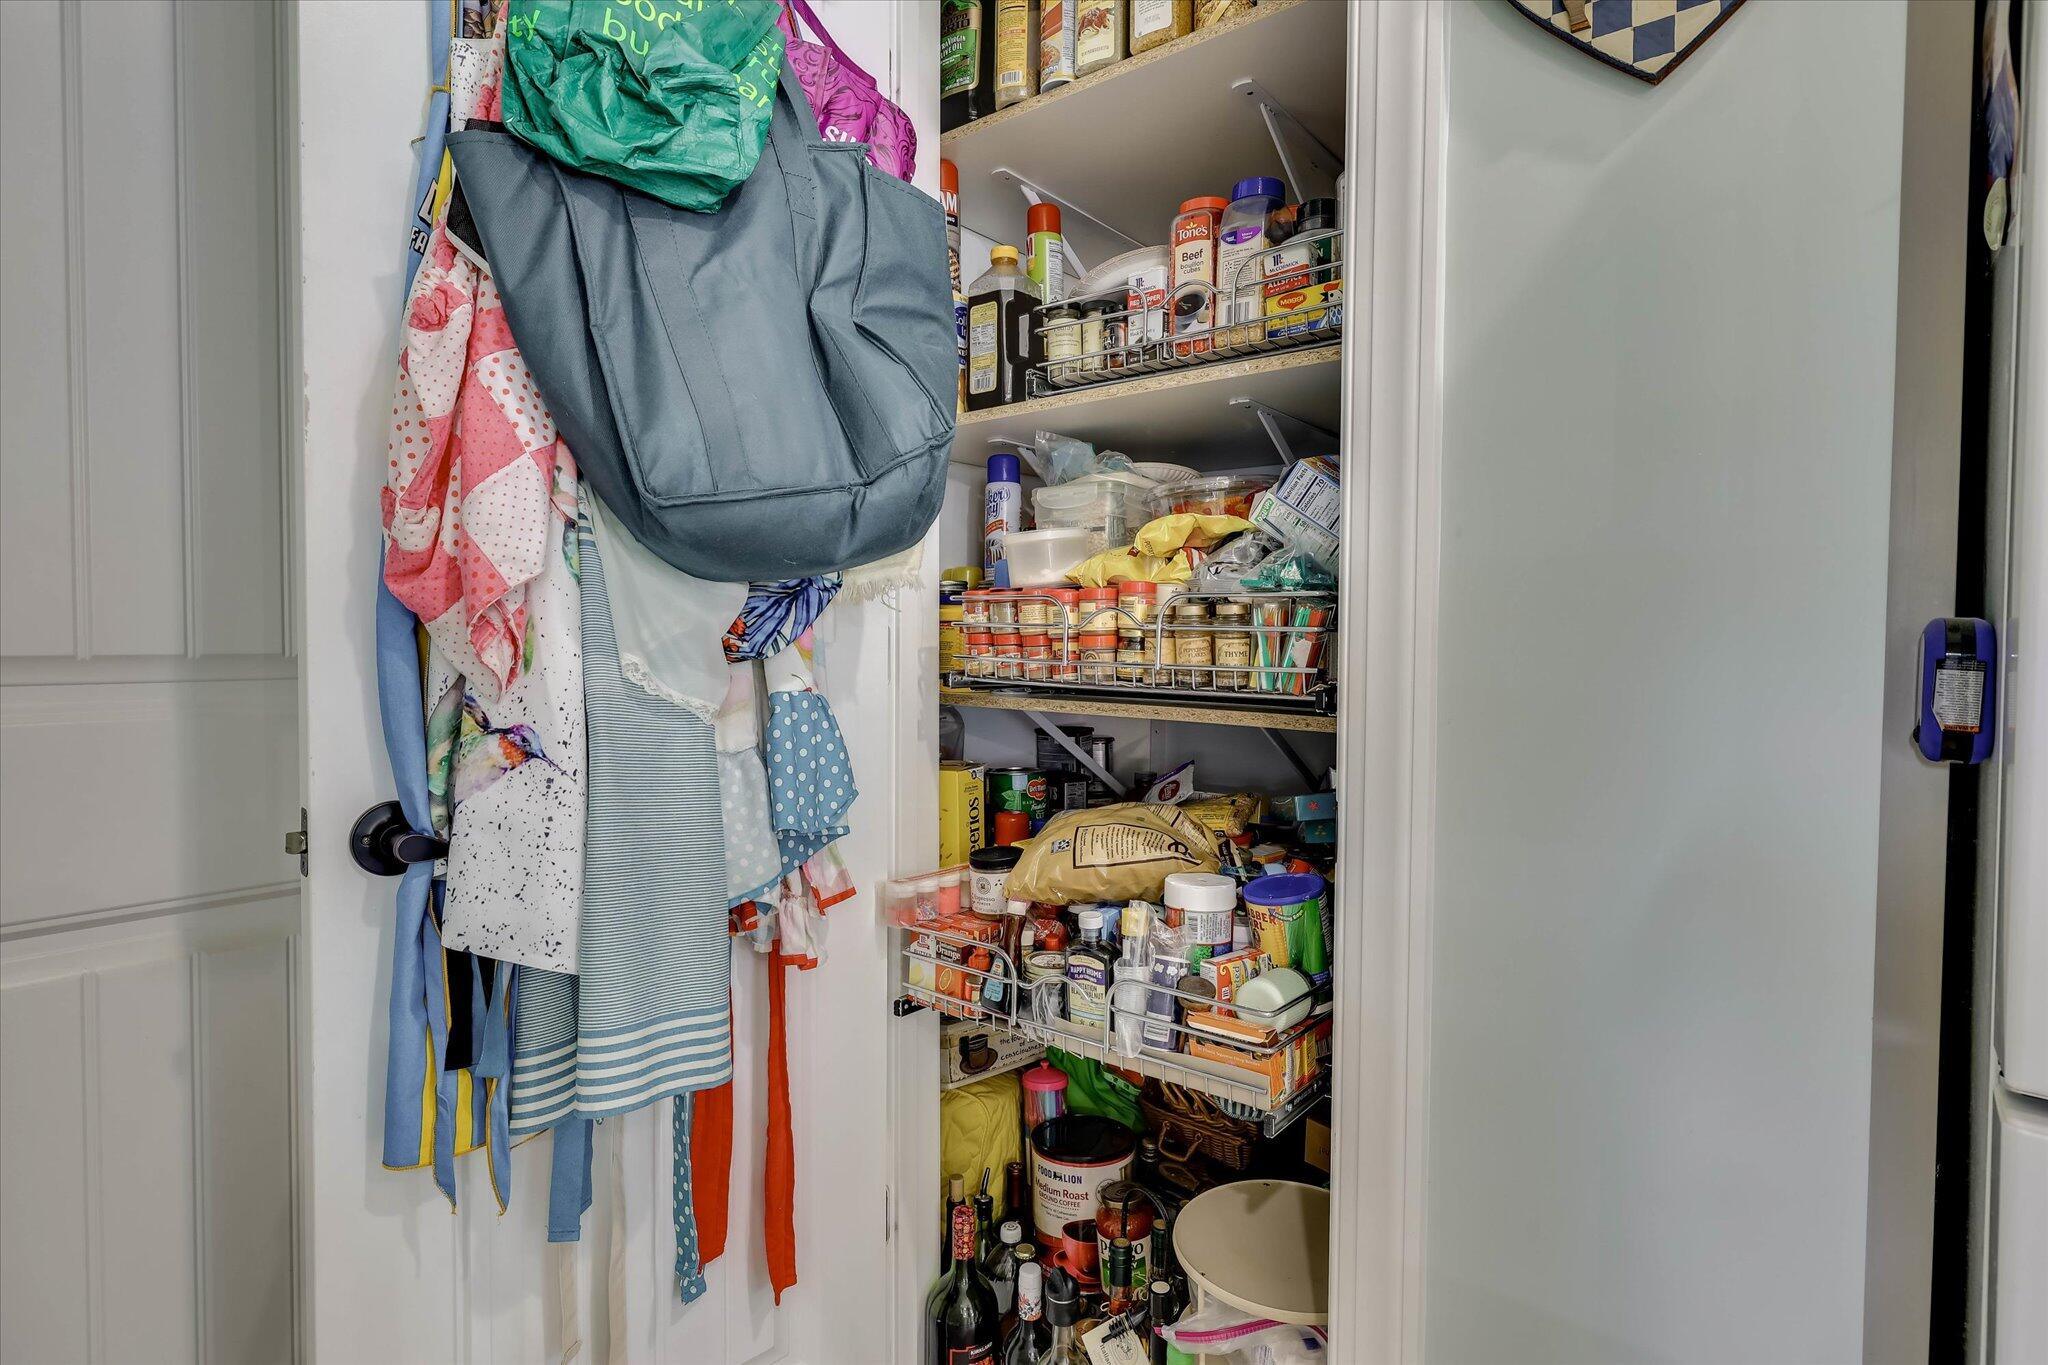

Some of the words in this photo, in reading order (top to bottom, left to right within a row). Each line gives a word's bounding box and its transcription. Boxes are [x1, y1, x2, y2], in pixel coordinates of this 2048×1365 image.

[1181, 249, 1204, 262] Beef
[1224, 650, 1249, 658] THYME
[1037, 1164, 1054, 1179] FOOD
[1062, 1175, 1083, 1184] LION
[1062, 1189, 1090, 1201] Roast
[1058, 1199, 1081, 1208] COFFEE
